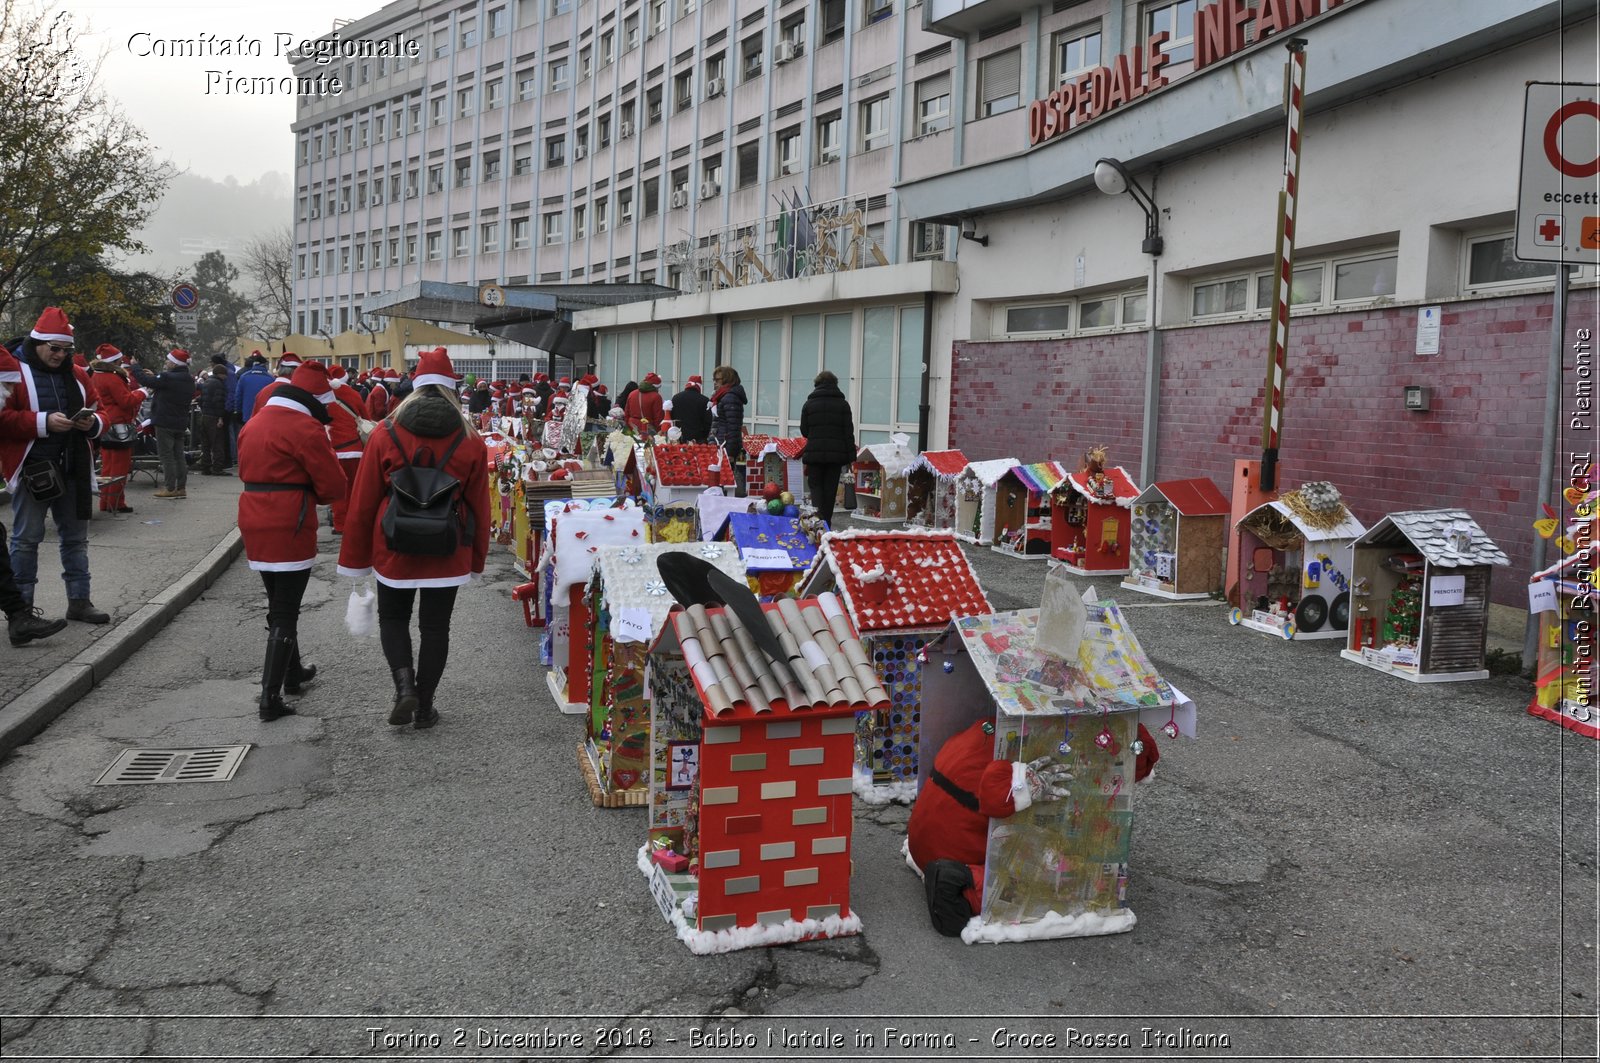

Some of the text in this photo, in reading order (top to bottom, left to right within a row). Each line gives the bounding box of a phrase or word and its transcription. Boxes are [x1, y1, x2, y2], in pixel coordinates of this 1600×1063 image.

[1028, 0, 1344, 146] OSPEDALE INFA
[1543, 191, 1600, 205] eccett
[1534, 591, 1551, 599] PREN
[619, 618, 643, 631] TATO
